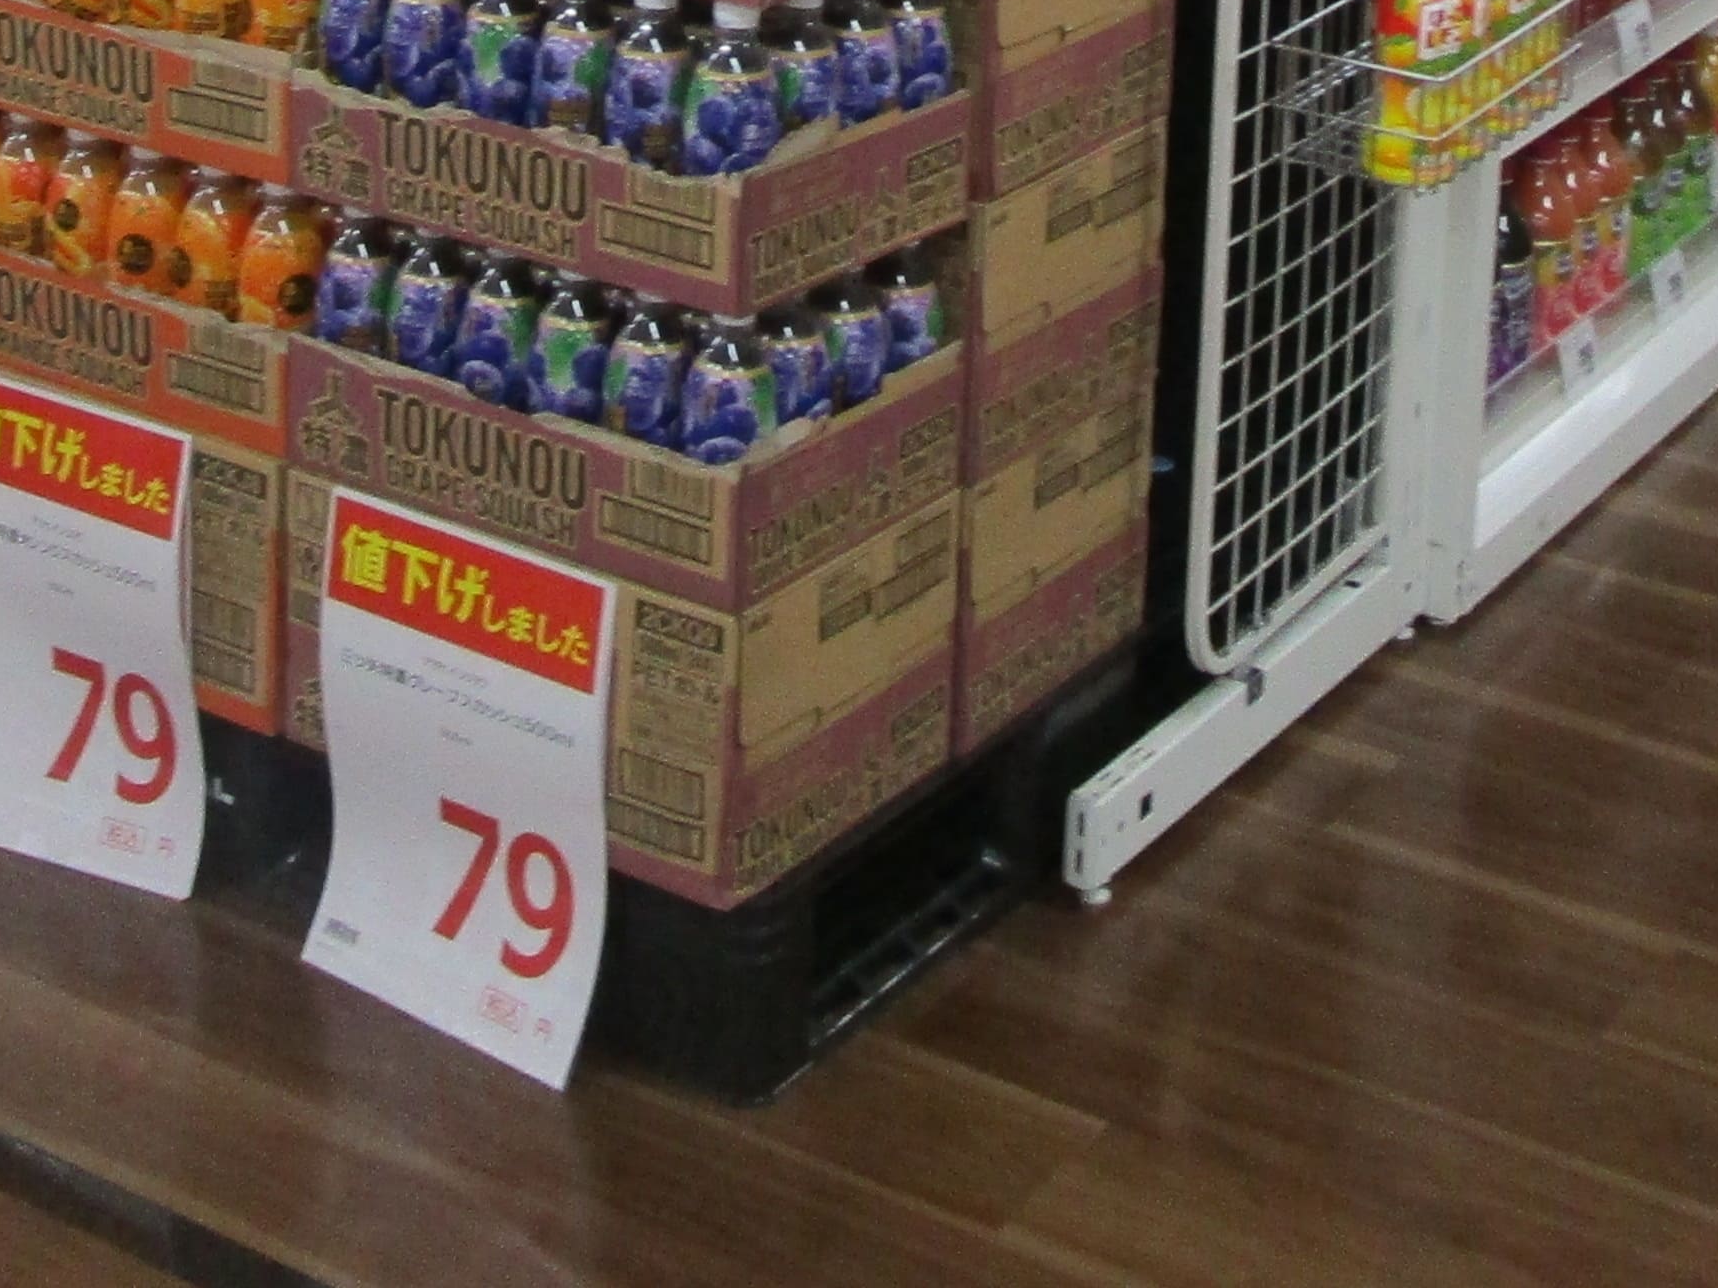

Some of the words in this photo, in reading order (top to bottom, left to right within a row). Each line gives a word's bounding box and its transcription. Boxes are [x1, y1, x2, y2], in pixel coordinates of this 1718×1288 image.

[380, 113, 588, 222] TOKUNOU
[389, 176, 465, 226] GRAPE
[480, 203, 576, 259] SQUASH
[377, 386, 587, 510] TOKUNOU
[386, 453, 465, 504] GRAPE
[479, 482, 574, 541] SQUASH
[341, 523, 592, 667] 値下げしました
[44, 645, 179, 805] 79
[432, 793, 576, 980] 79
